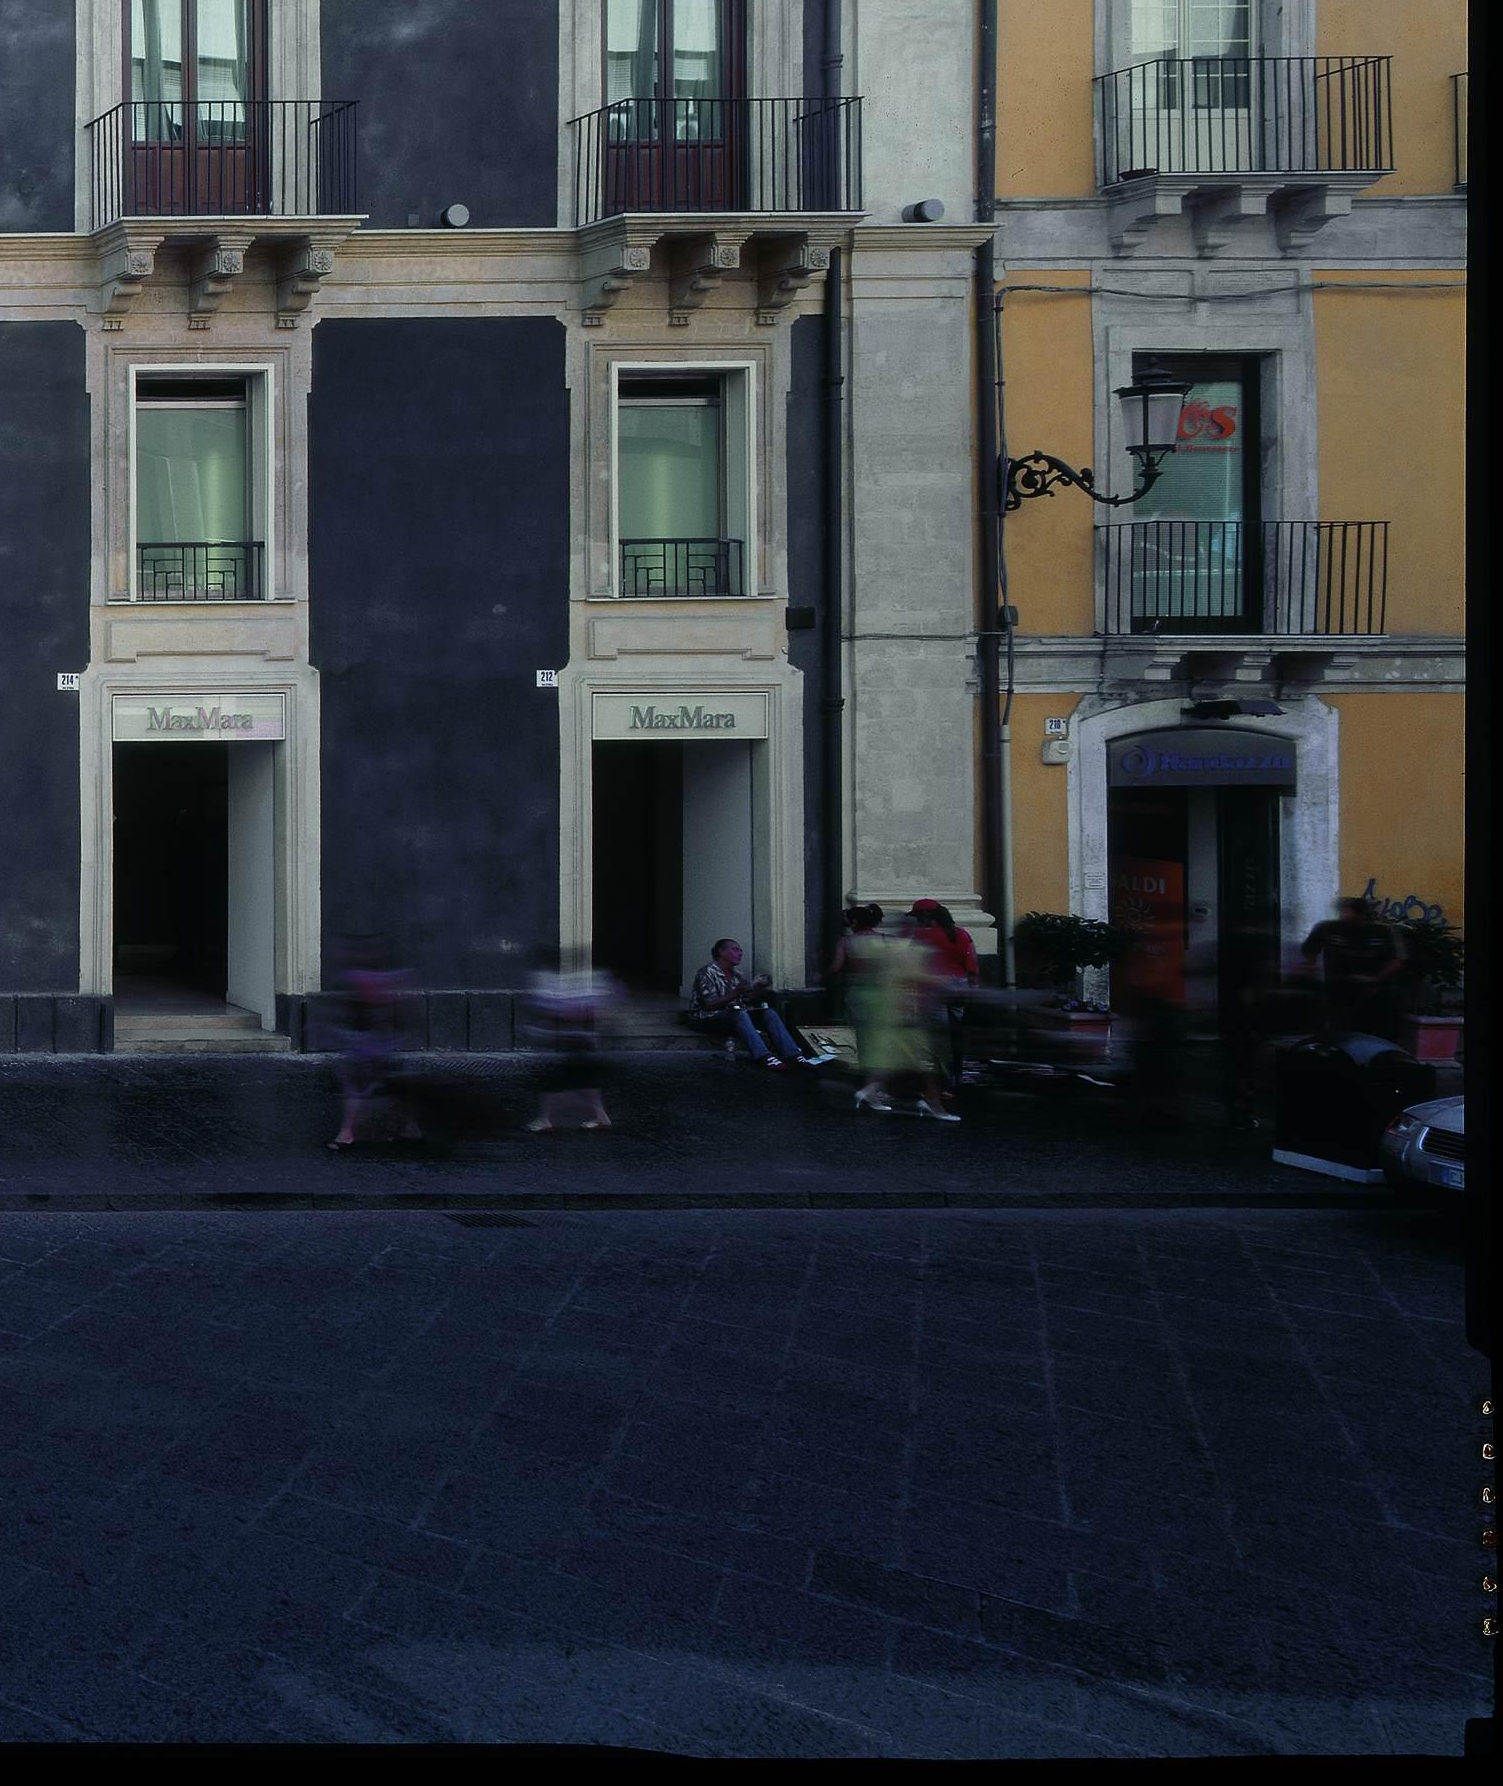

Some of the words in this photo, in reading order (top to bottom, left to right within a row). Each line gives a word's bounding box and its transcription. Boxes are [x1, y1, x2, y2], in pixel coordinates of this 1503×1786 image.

[146, 706, 254, 732] MaxMara
[628, 705, 737, 730] MaxMara
[1112, 875, 1166, 895] ALDI
